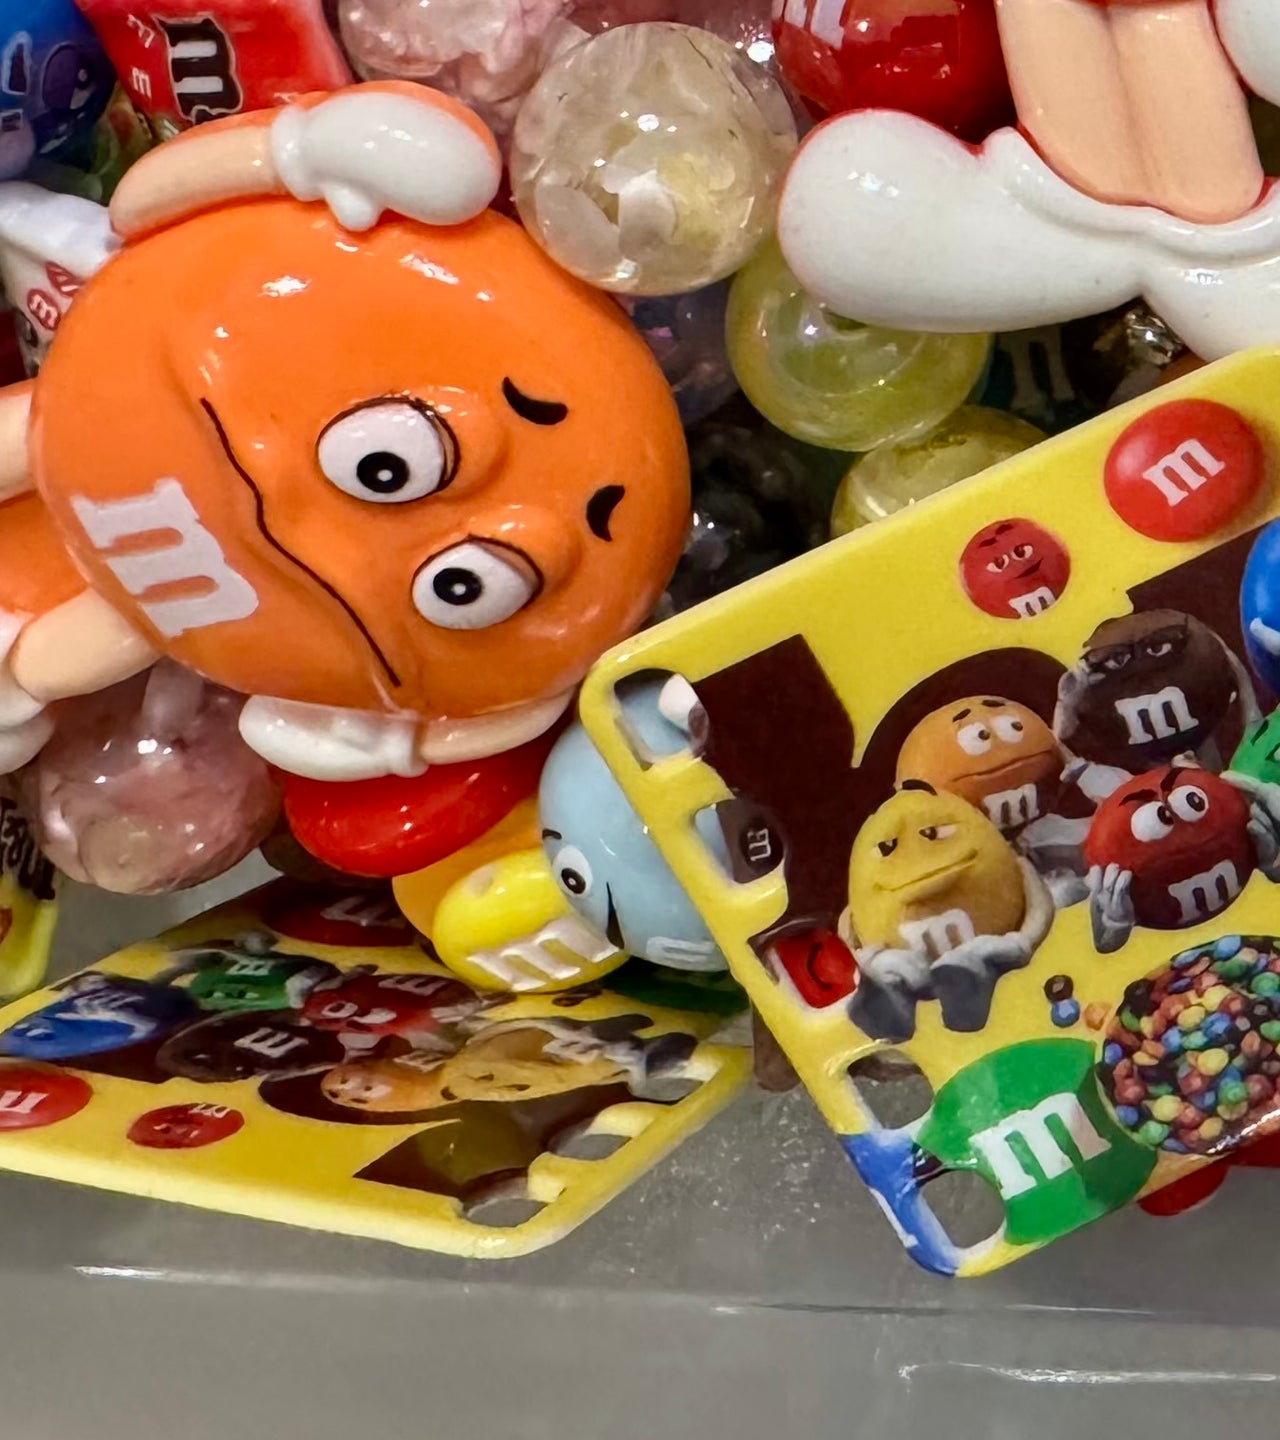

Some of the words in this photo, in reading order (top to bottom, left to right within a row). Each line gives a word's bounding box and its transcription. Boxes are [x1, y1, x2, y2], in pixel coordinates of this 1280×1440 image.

[131, 66, 152, 100] m
[1142, 439, 1225, 506] m
[70, 477, 259, 637] m
[1008, 586, 1055, 618] m
[1115, 686, 1198, 744] m
[983, 783, 1039, 826] m
[1168, 860, 1242, 924] m
[467, 917, 620, 992] m
[899, 910, 974, 958] m
[235, 1027, 308, 1057] m
[970, 1093, 1111, 1200] m
